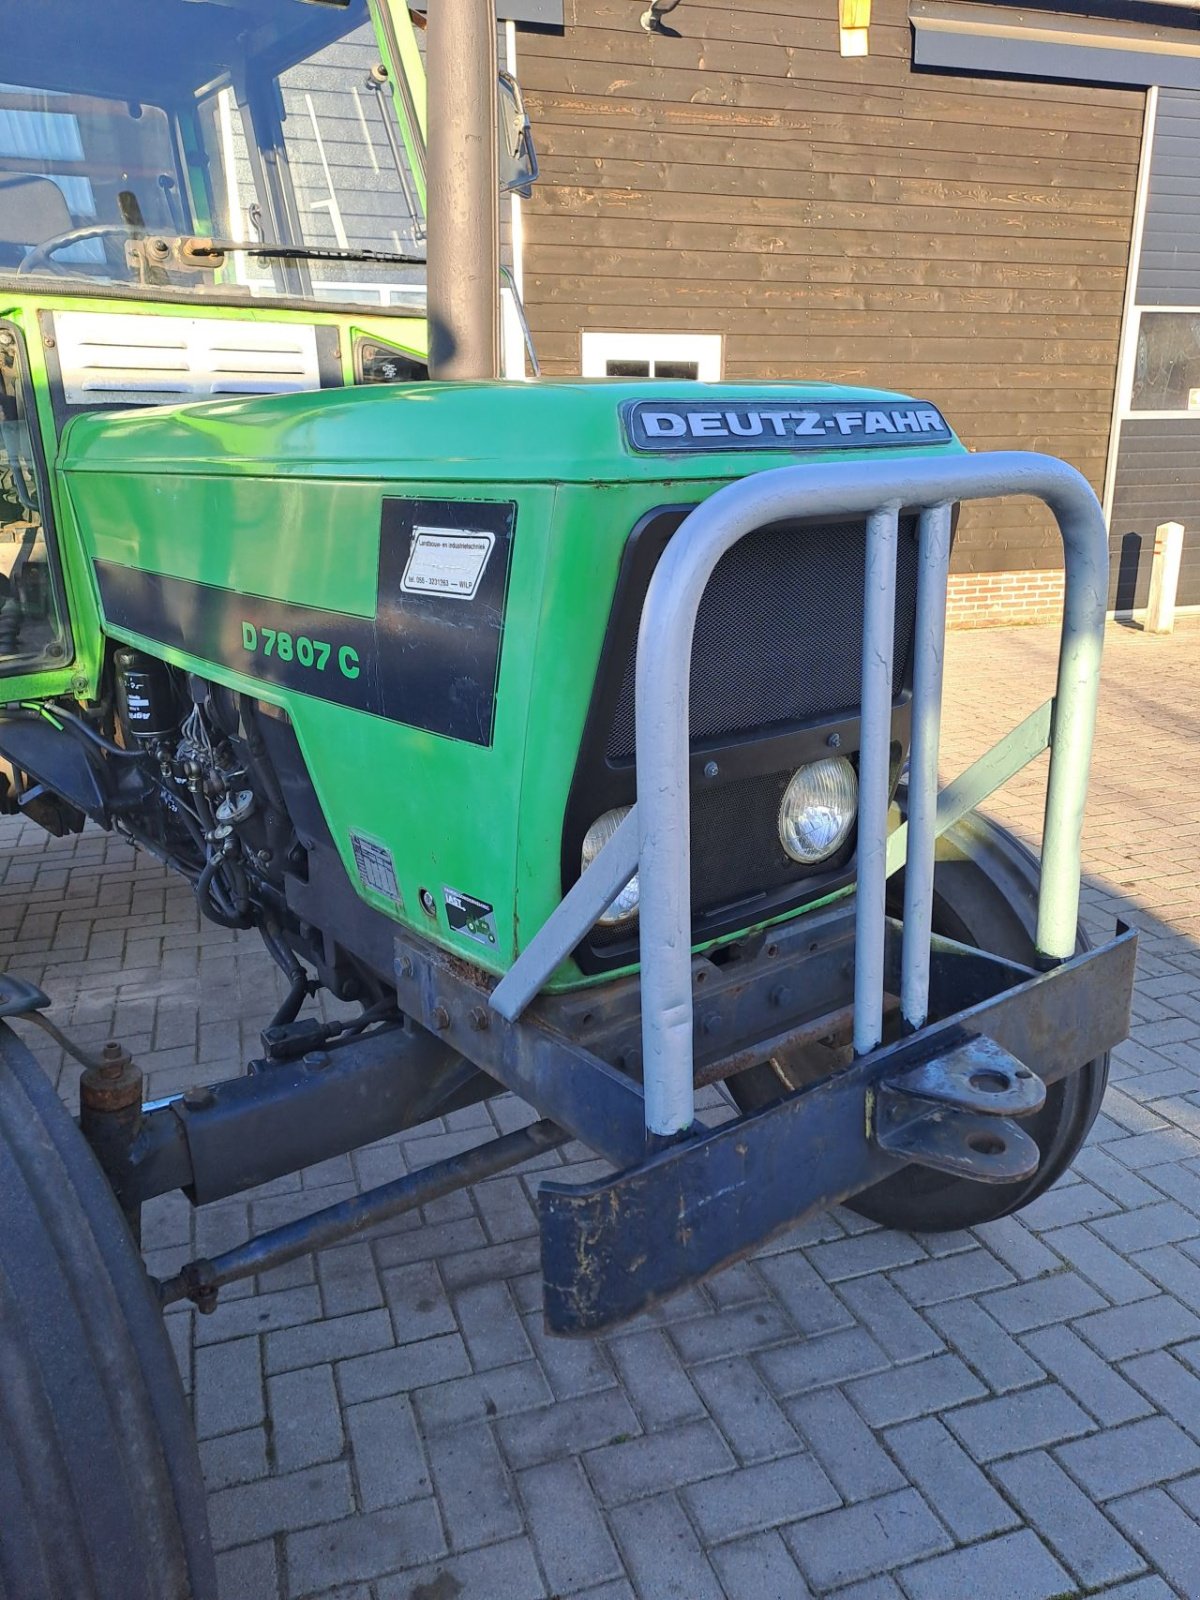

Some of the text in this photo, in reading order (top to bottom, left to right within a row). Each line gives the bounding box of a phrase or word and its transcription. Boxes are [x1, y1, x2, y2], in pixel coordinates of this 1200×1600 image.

[640, 410, 944, 438] DEUTZ-FAHR
[241, 621, 360, 679] D 7807 C
